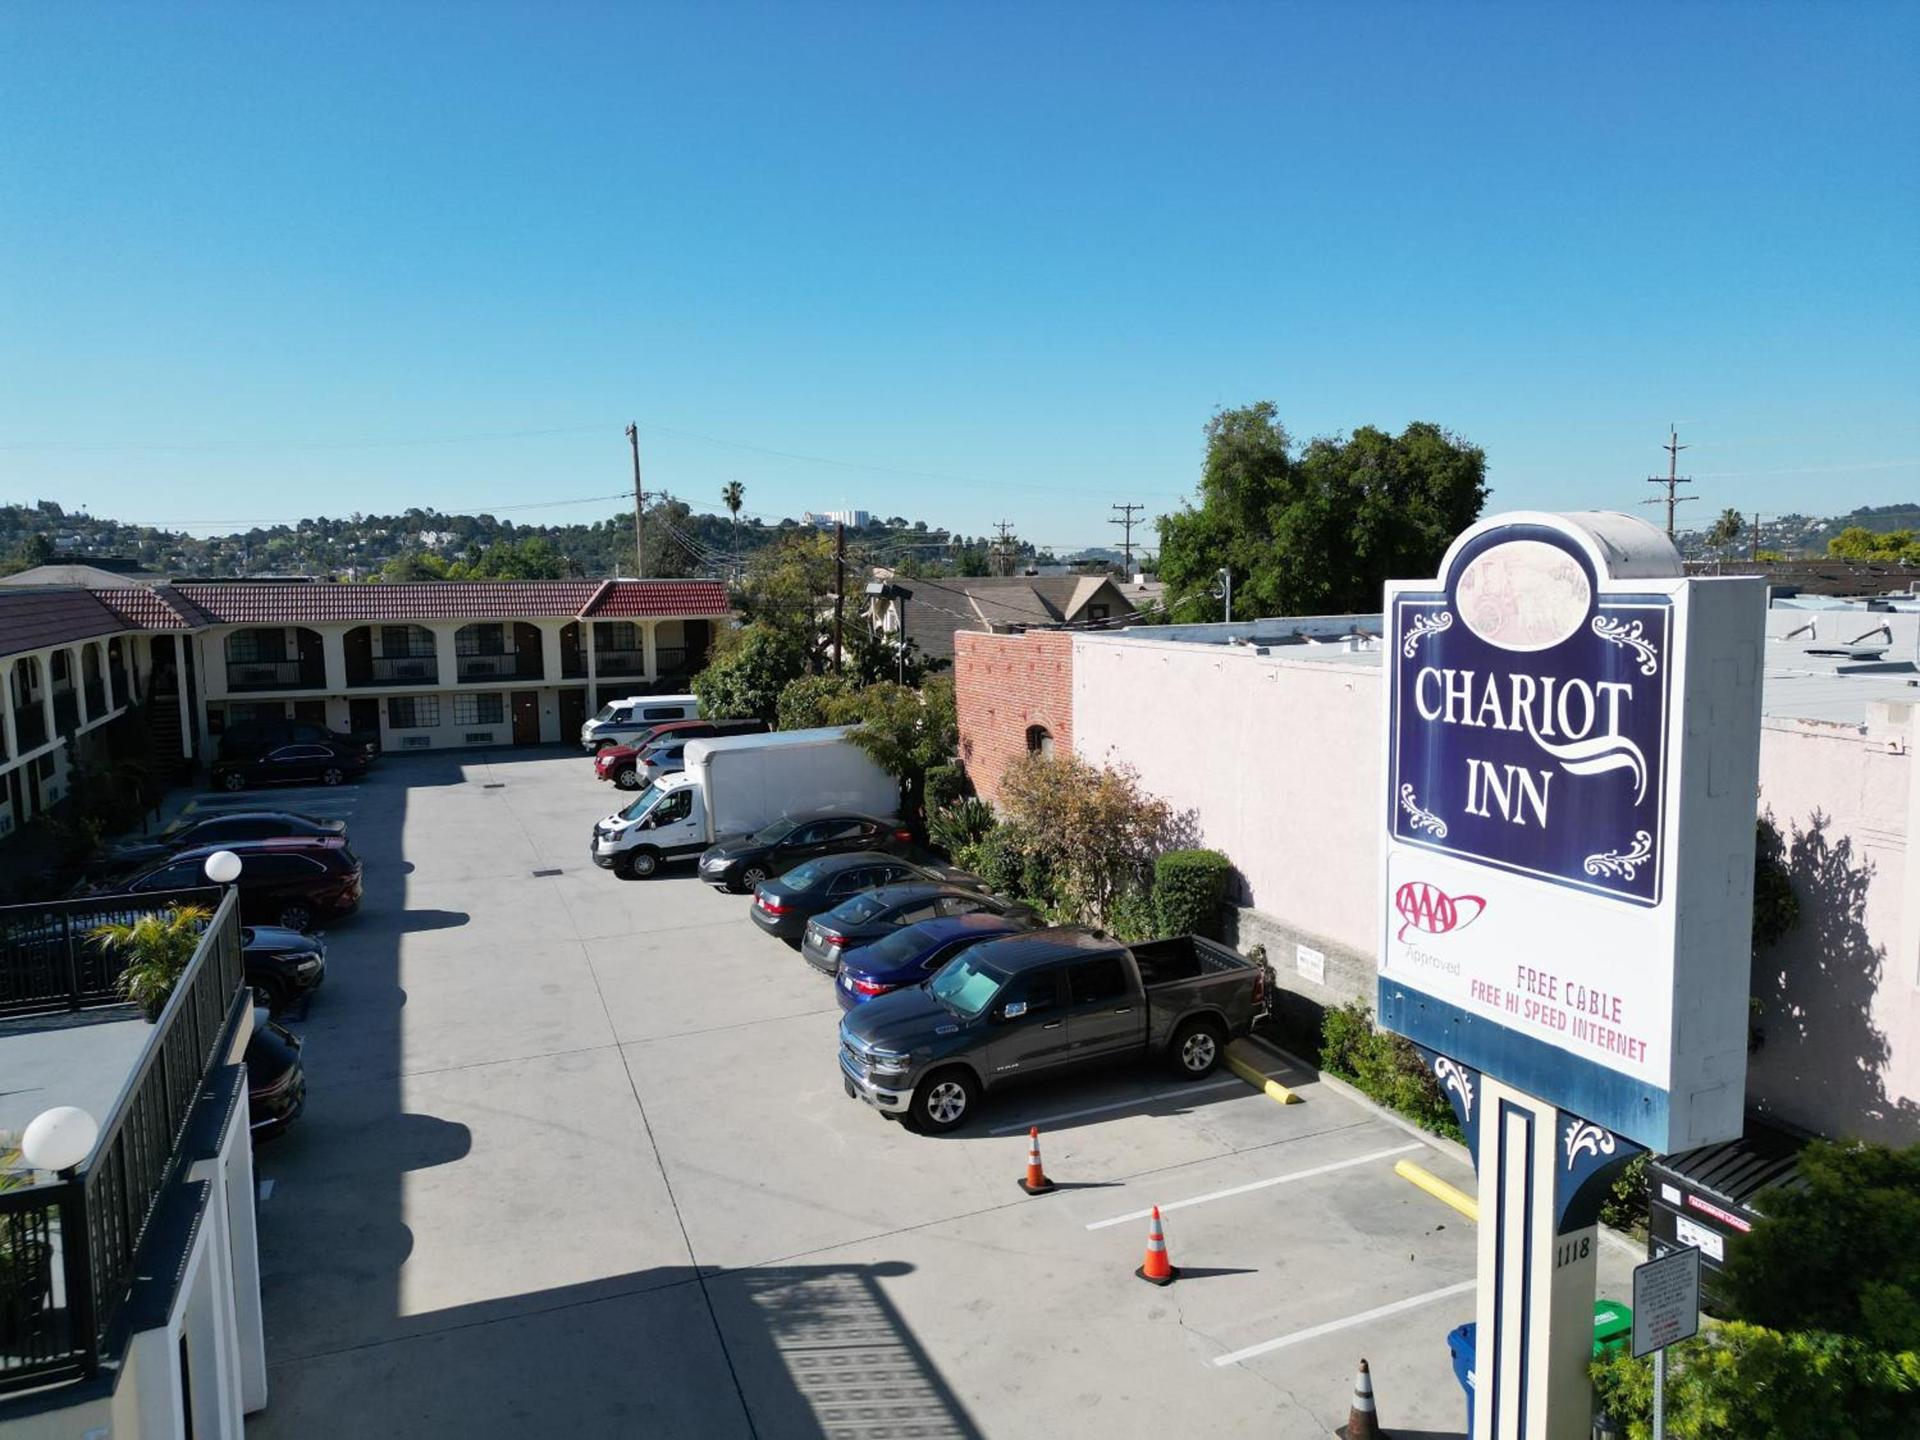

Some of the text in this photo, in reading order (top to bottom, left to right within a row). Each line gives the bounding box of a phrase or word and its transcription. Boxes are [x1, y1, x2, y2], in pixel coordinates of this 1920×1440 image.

[1415, 665, 1640, 768] CHARIOT
[1464, 758, 1553, 829] INN
[1397, 881, 1457, 933] AAA
[1406, 944, 1461, 977] Approved
[1471, 979, 1648, 1064] FREE HI SPEED INTERNET
[1517, 965, 1623, 1025] FREE CABLE
[1557, 1236, 1590, 1269] 1118
